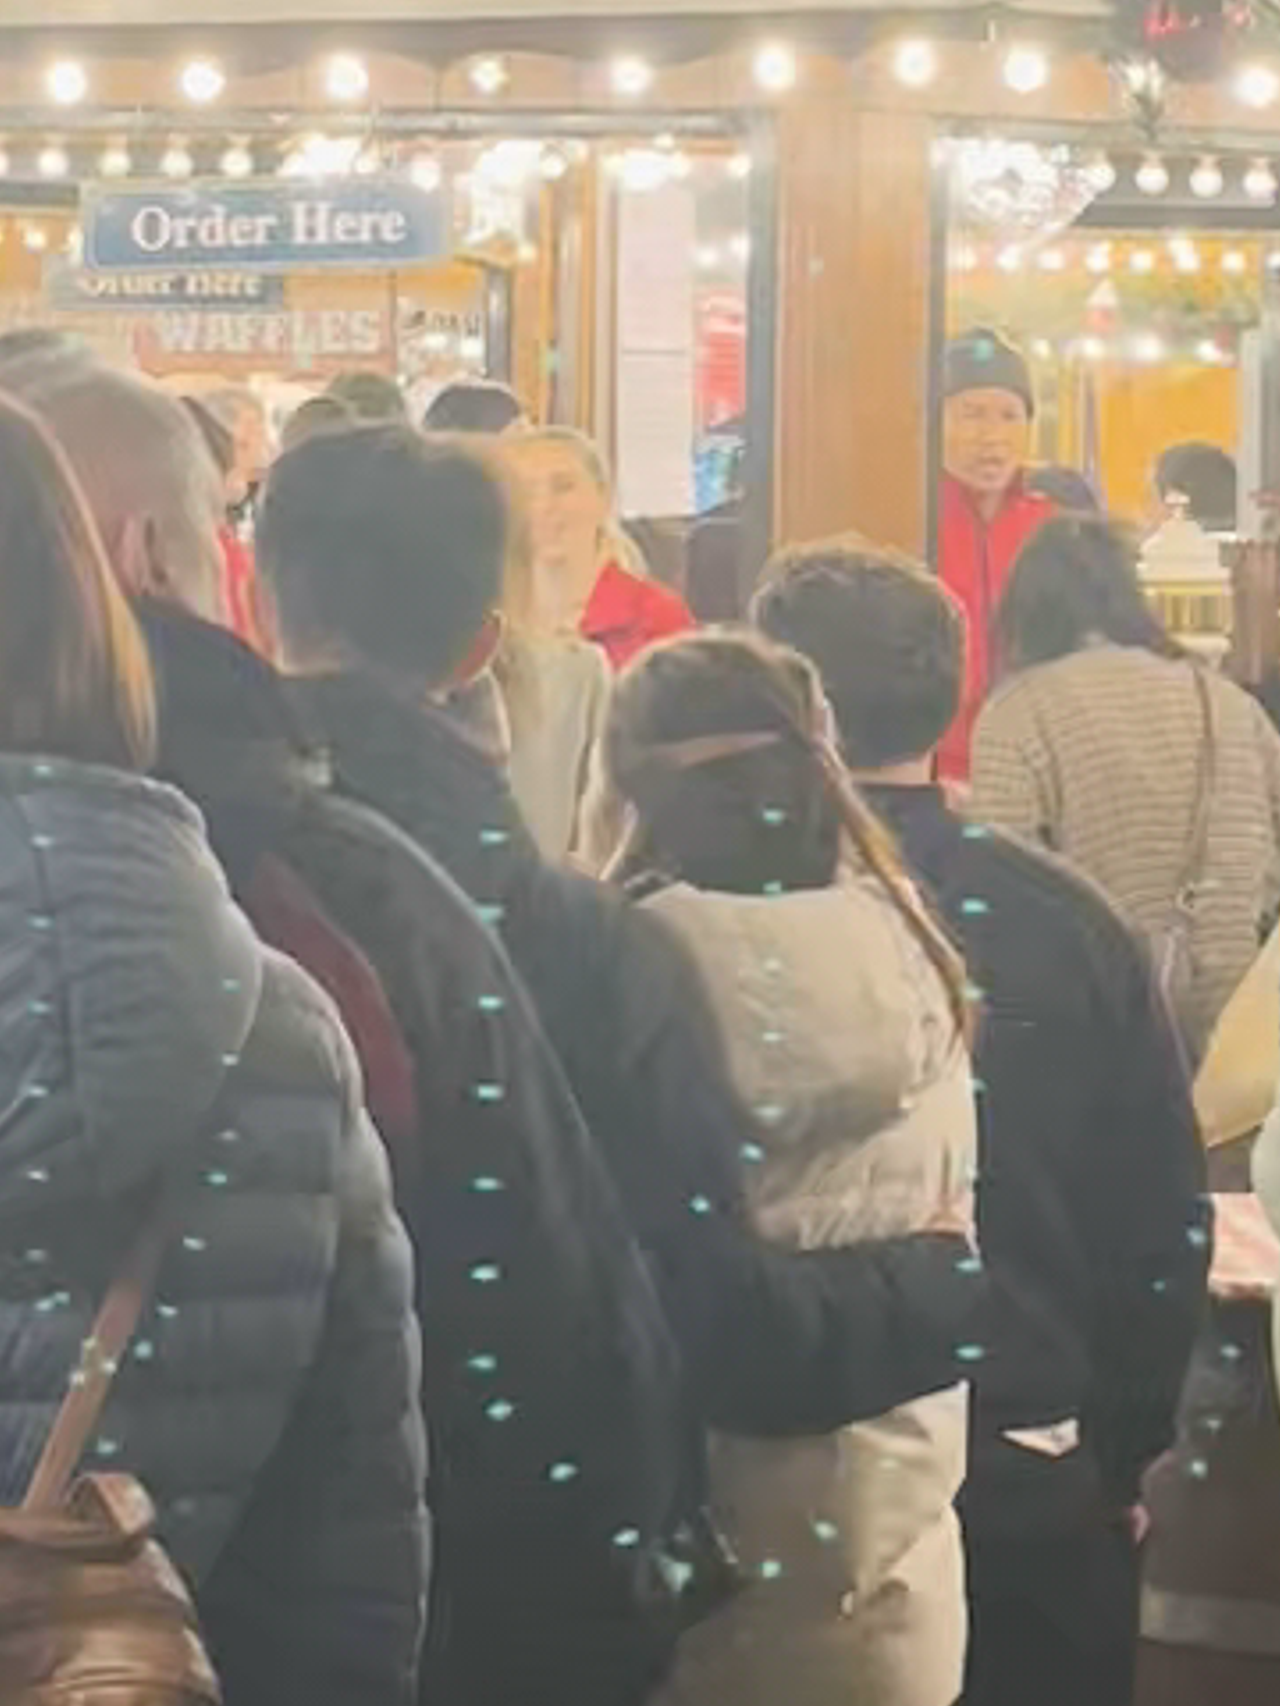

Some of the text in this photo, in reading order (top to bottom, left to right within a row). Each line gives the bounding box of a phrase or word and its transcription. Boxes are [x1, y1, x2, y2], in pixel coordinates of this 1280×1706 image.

[130, 200, 408, 252] Order Here
[157, 307, 382, 354] WAFFLES
